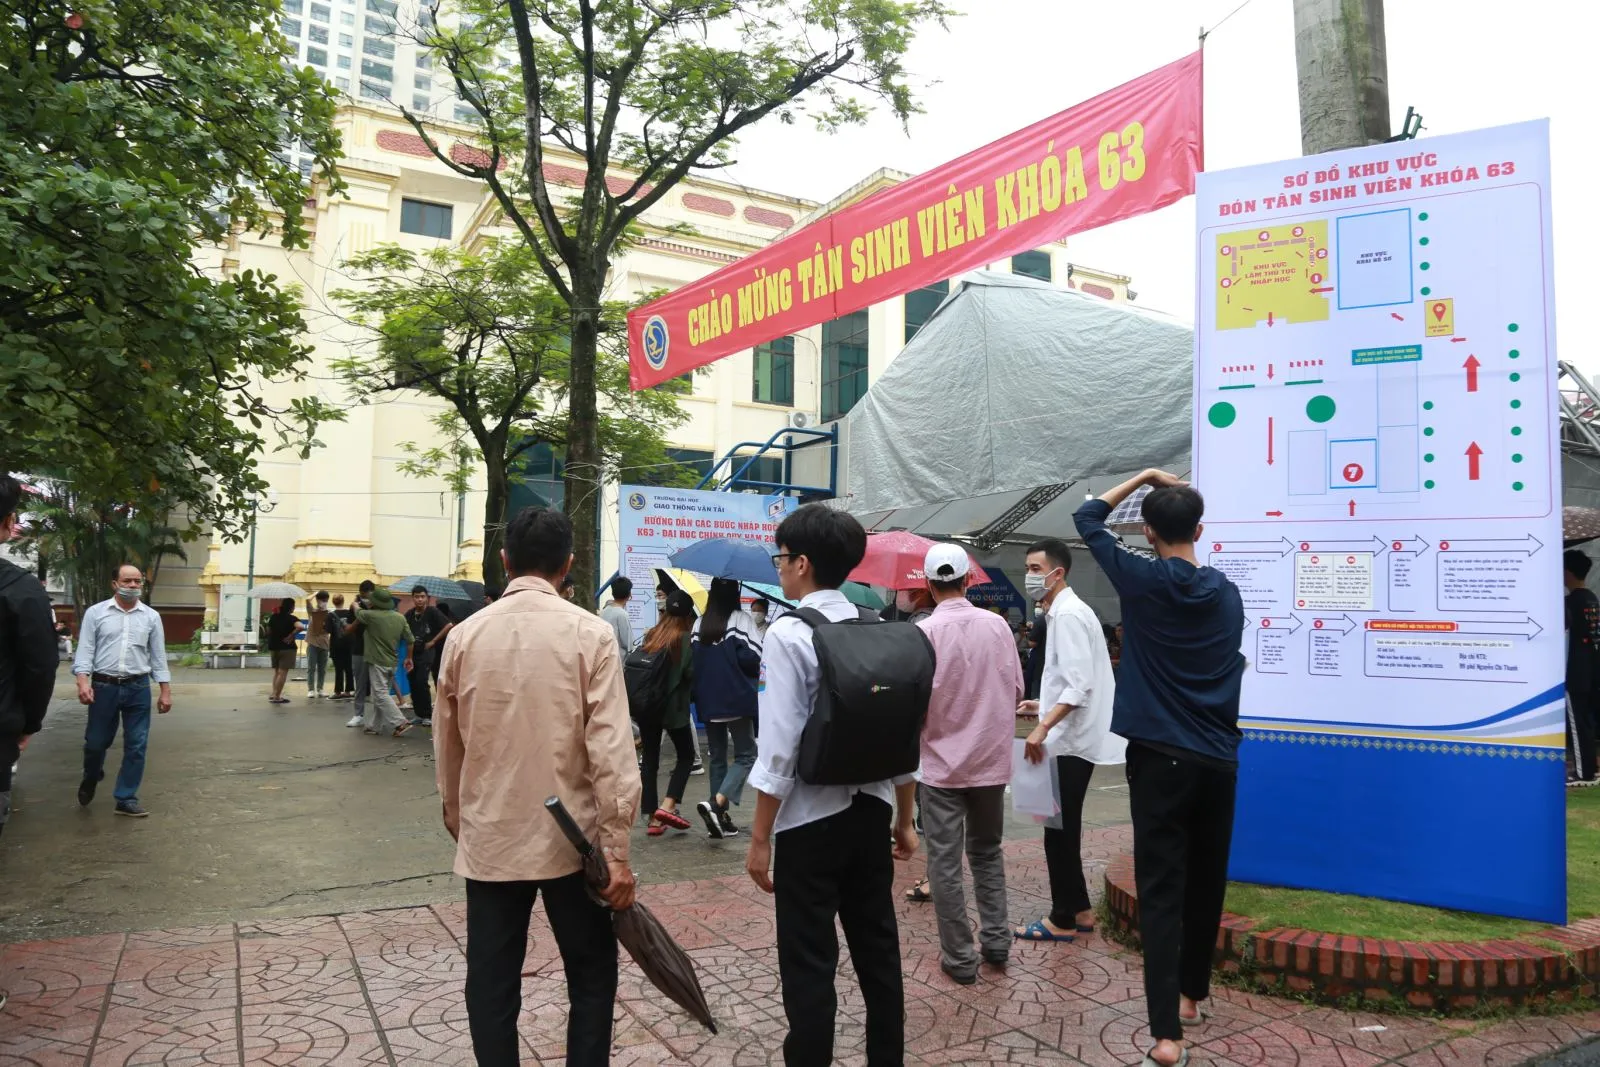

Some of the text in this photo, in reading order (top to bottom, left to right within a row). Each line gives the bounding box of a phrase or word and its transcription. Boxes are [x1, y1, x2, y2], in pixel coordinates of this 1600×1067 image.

[1283, 152, 1437, 189] SƠ ĐỒ KHU VỰC
[1219, 161, 1516, 216] ĐÓN TÂN SINH VIÊN KHÓA 63
[688, 122, 1146, 347] CHÀO MỪNG TÂN SINH VIÊN KHÓA 63
[1253, 261, 1288, 271] KHU VỰC
[1274, 275, 1291, 284] HỌC
[698, 504, 712, 512] VẬN
[713, 505, 725, 513] TẢI
[644, 515, 673, 526] HƯỚNG
[675, 515, 693, 528] DẪN
[695, 517, 711, 528] CÁC
[713, 518, 736, 529] BƯỚC
[737, 520, 760, 532] NHẬP
[637, 527, 654, 537] K63
[662, 529, 677, 539] ĐẠI
[679, 530, 697, 540] HỌC
